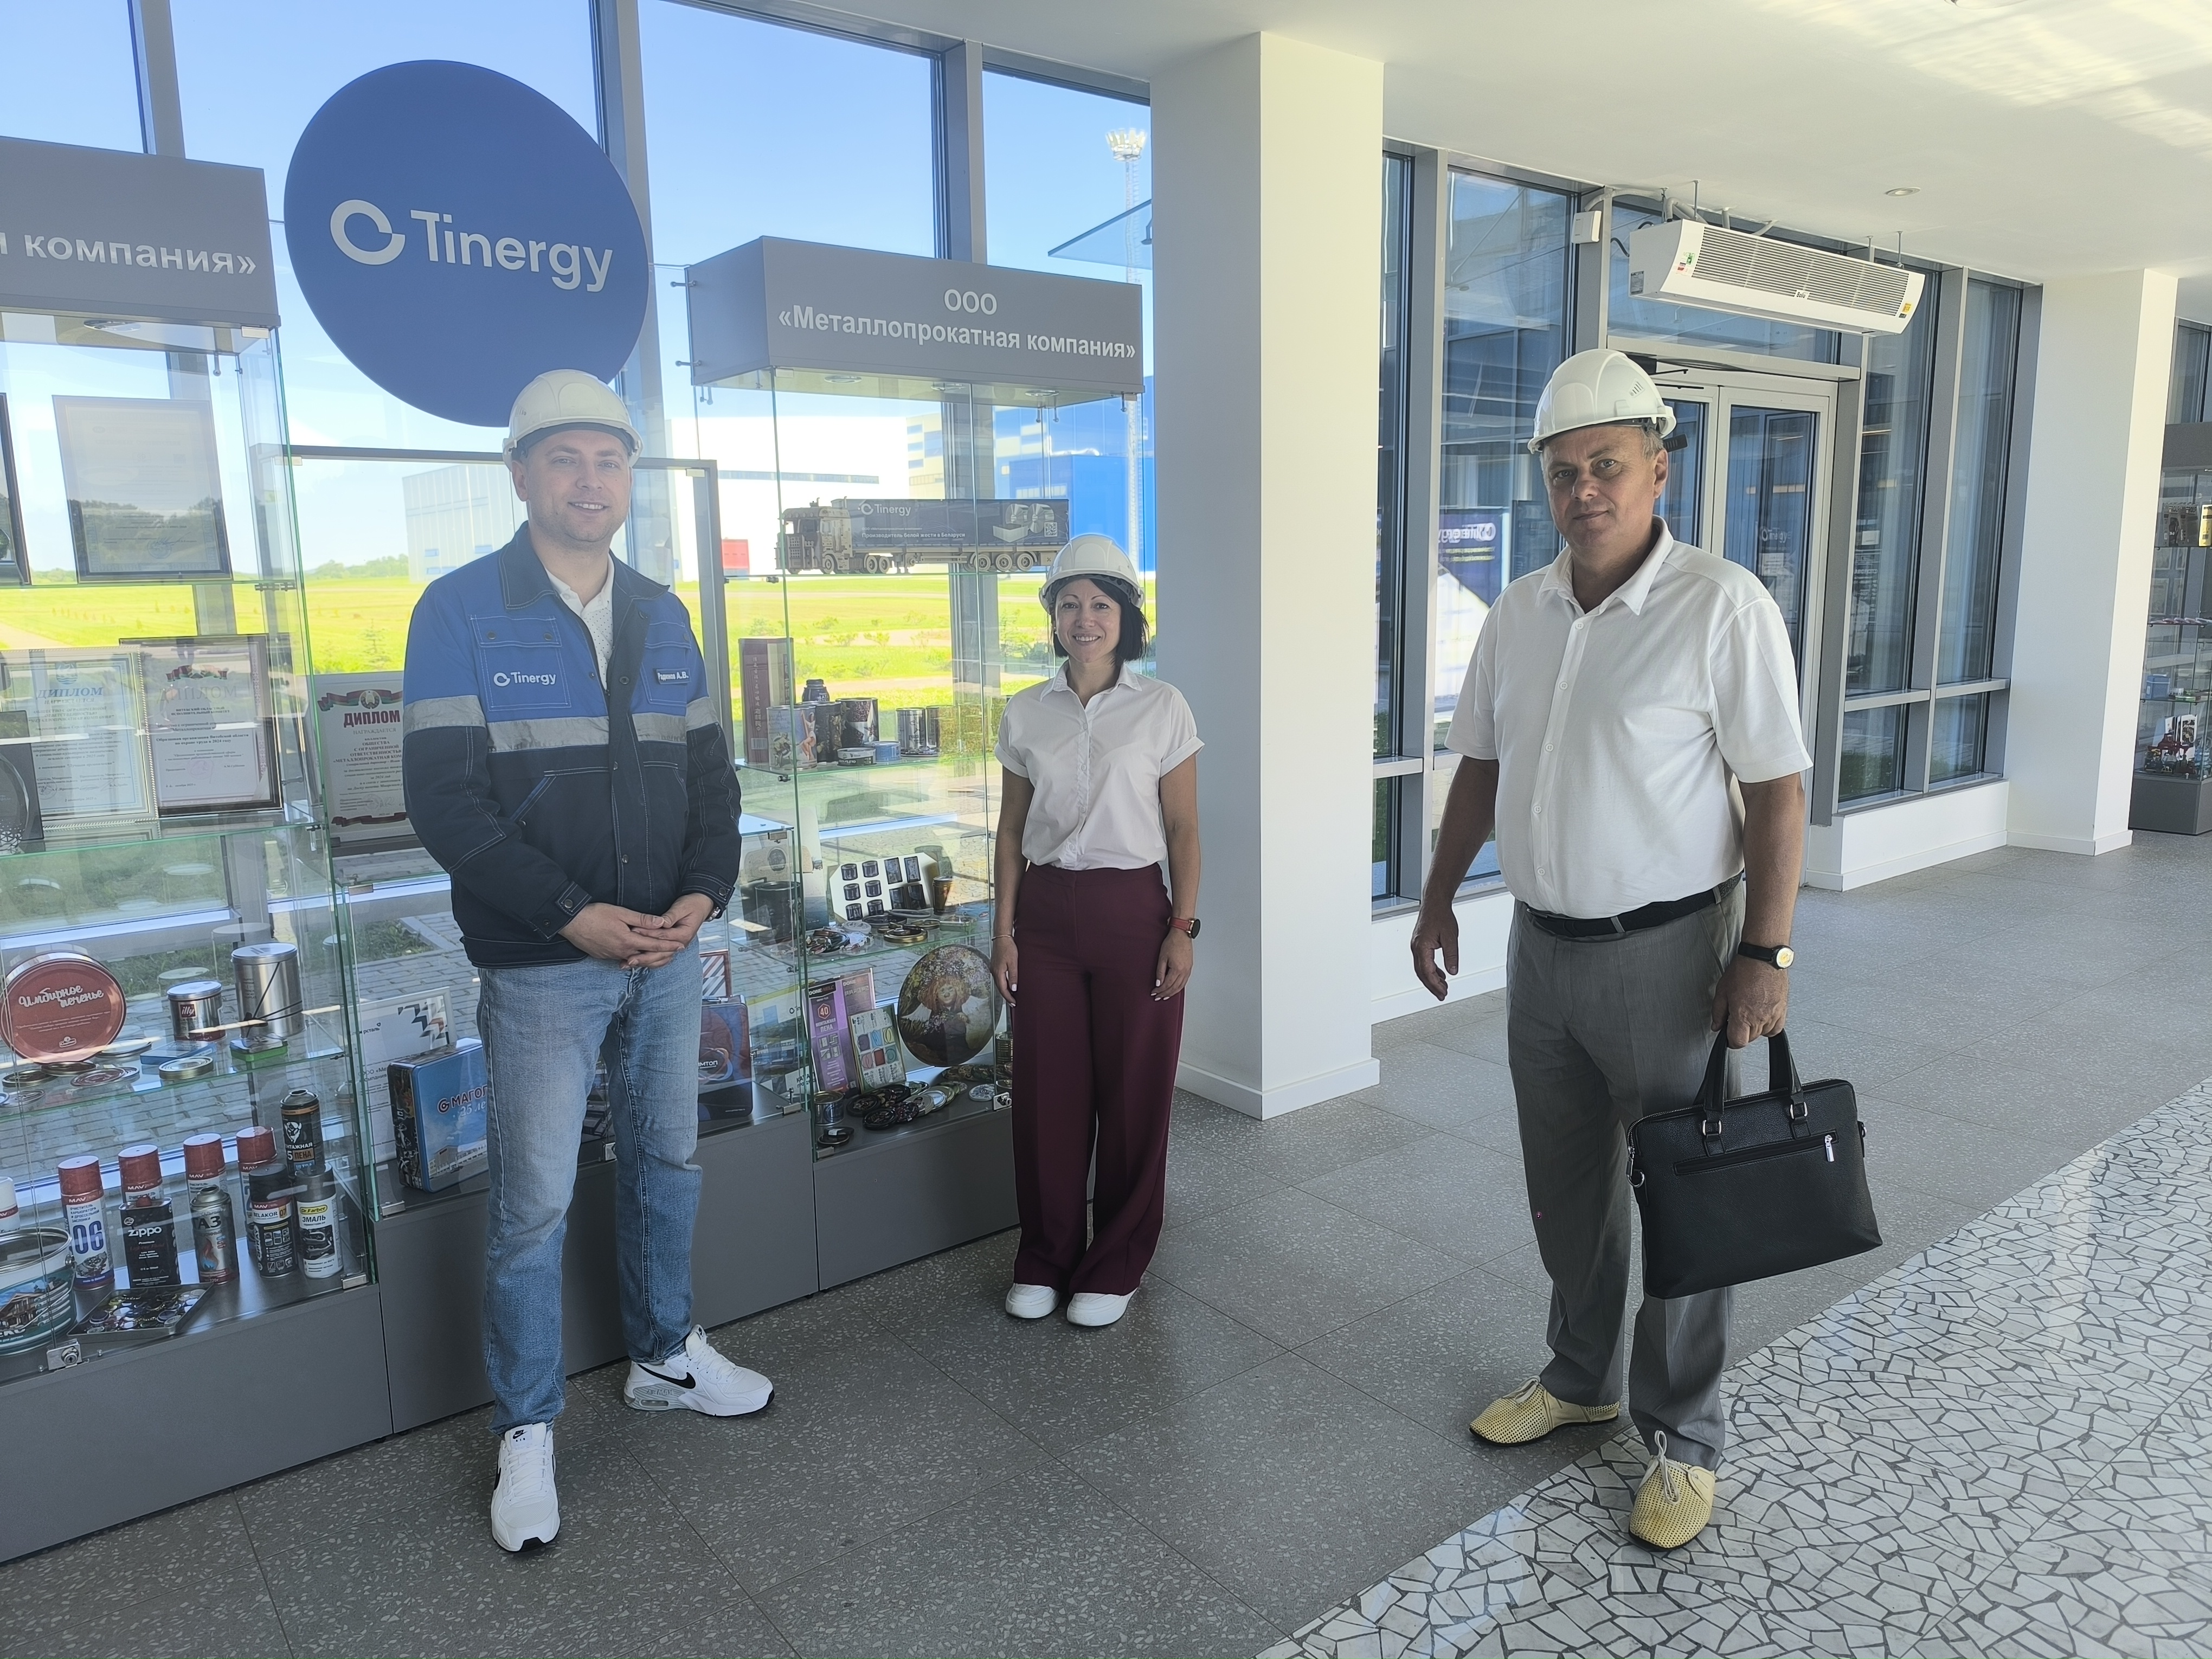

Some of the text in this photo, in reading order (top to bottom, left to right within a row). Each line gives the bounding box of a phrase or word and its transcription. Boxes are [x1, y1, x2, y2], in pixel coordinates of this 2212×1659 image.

[24, 234, 256, 274] компания»
[410, 209, 613, 292] Tinergy
[943, 288, 998, 315] ООО
[778, 305, 1136, 358] «Металлопрокатная компания»
[874, 504, 911, 516] Tinergy
[510, 672, 556, 685] Tinergy
[37, 687, 104, 699] ДИПЛОМ
[157, 685, 238, 704] ДИПЛОМ
[343, 710, 401, 728] ДИПЛОМ
[18, 985, 83, 1007] Имбирное
[58, 989, 104, 1008] печенье
[182, 1006, 195, 1016] illy
[820, 1007, 829, 1016] 40
[820, 1024, 834, 1033] ПЕНА
[460, 1101, 487, 1117] 25 ле
[294, 1150, 312, 1160] ПЕНА
[279, 1208, 287, 1217] 07
[302, 1214, 326, 1223] ЭМАЛЬ
[73, 1220, 104, 1255] 06
